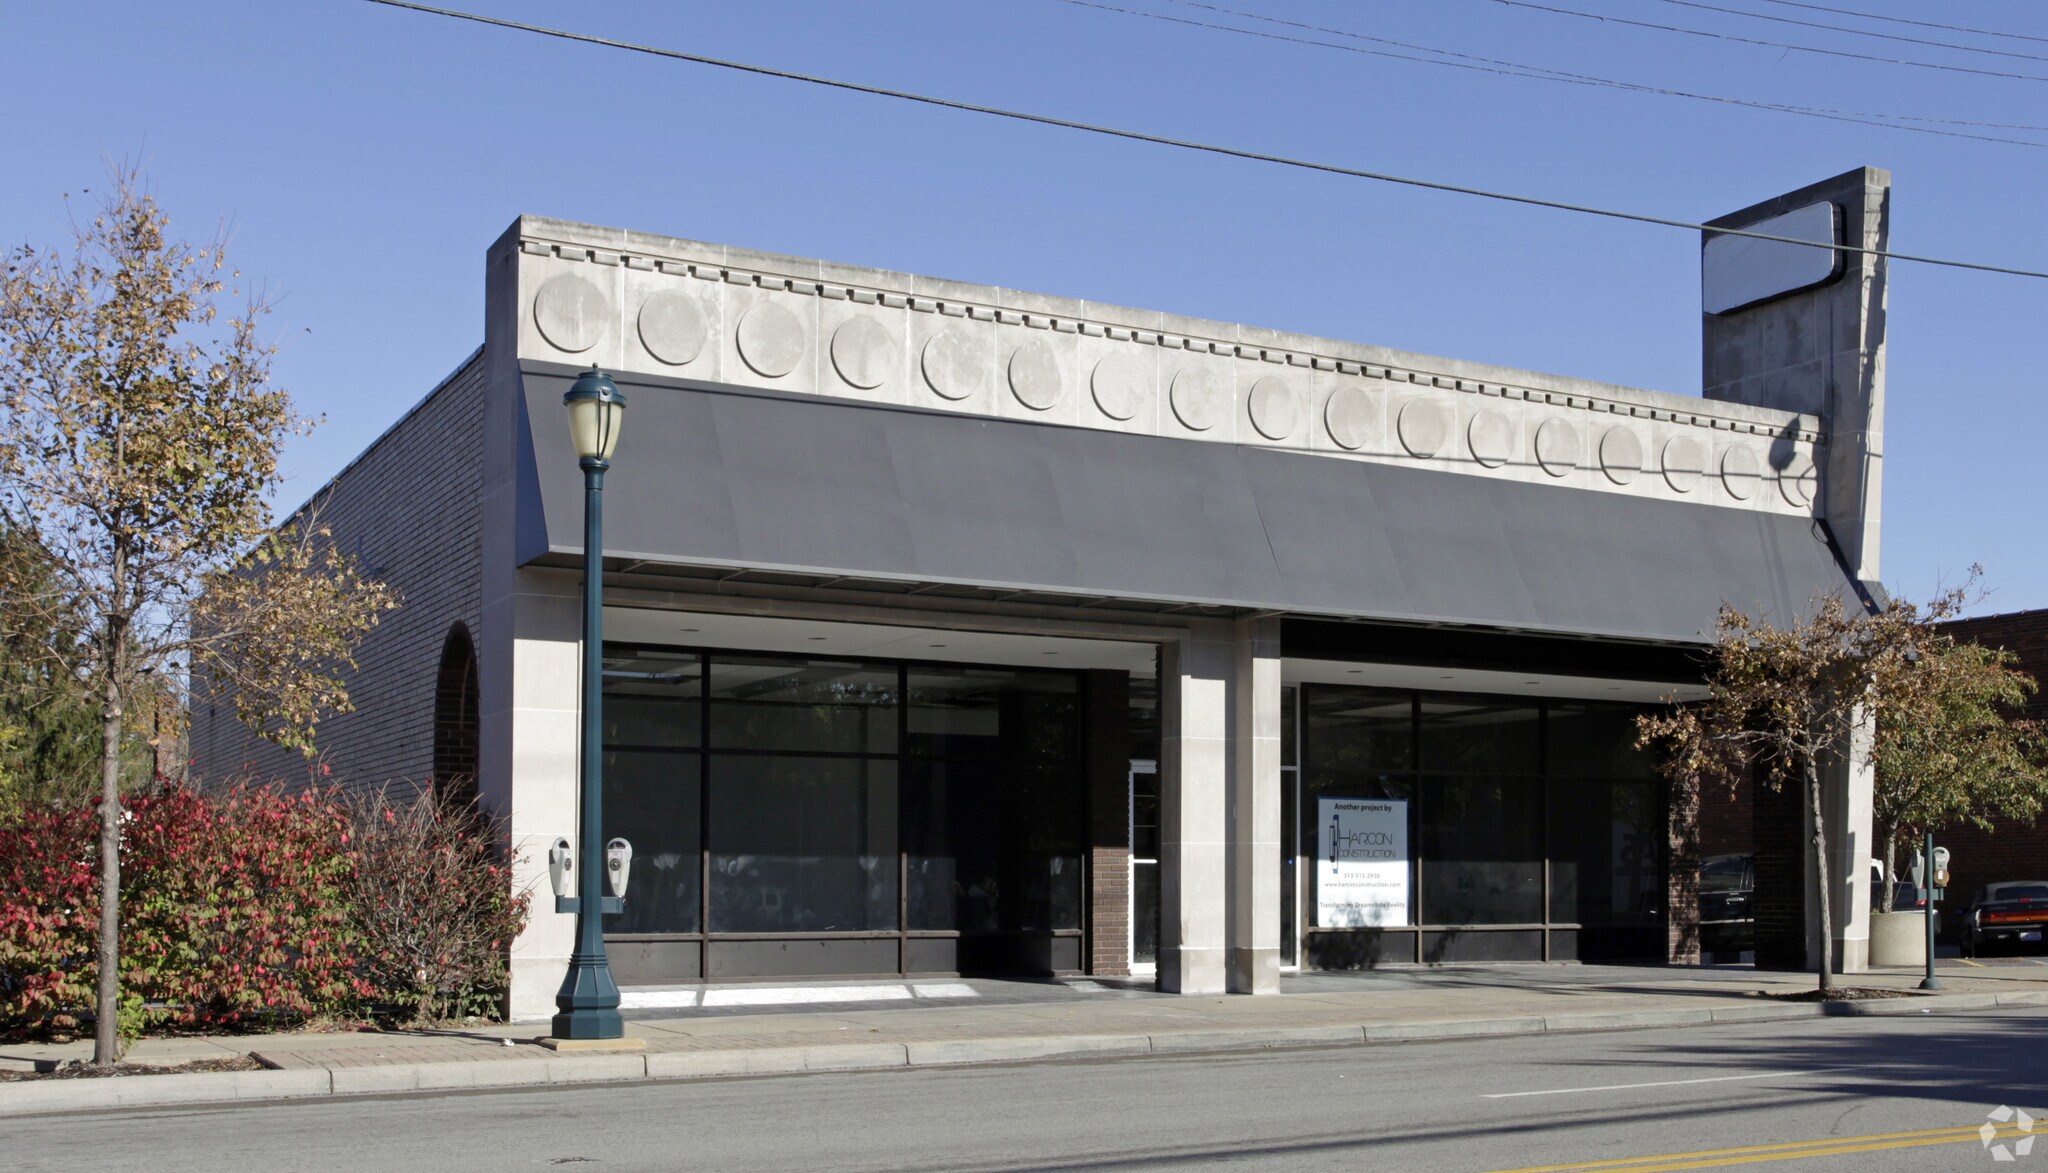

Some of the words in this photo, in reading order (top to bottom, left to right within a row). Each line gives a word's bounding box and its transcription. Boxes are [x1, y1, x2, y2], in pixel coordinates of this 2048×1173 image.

[1360, 804, 1383, 813] project
[1384, 804, 1392, 812] by
[1338, 829, 1392, 848] HARCON
[1338, 849, 1395, 858] CONSTRUCTION
[1320, 902, 1354, 910] Transforming
[1387, 902, 1405, 910] Reality
